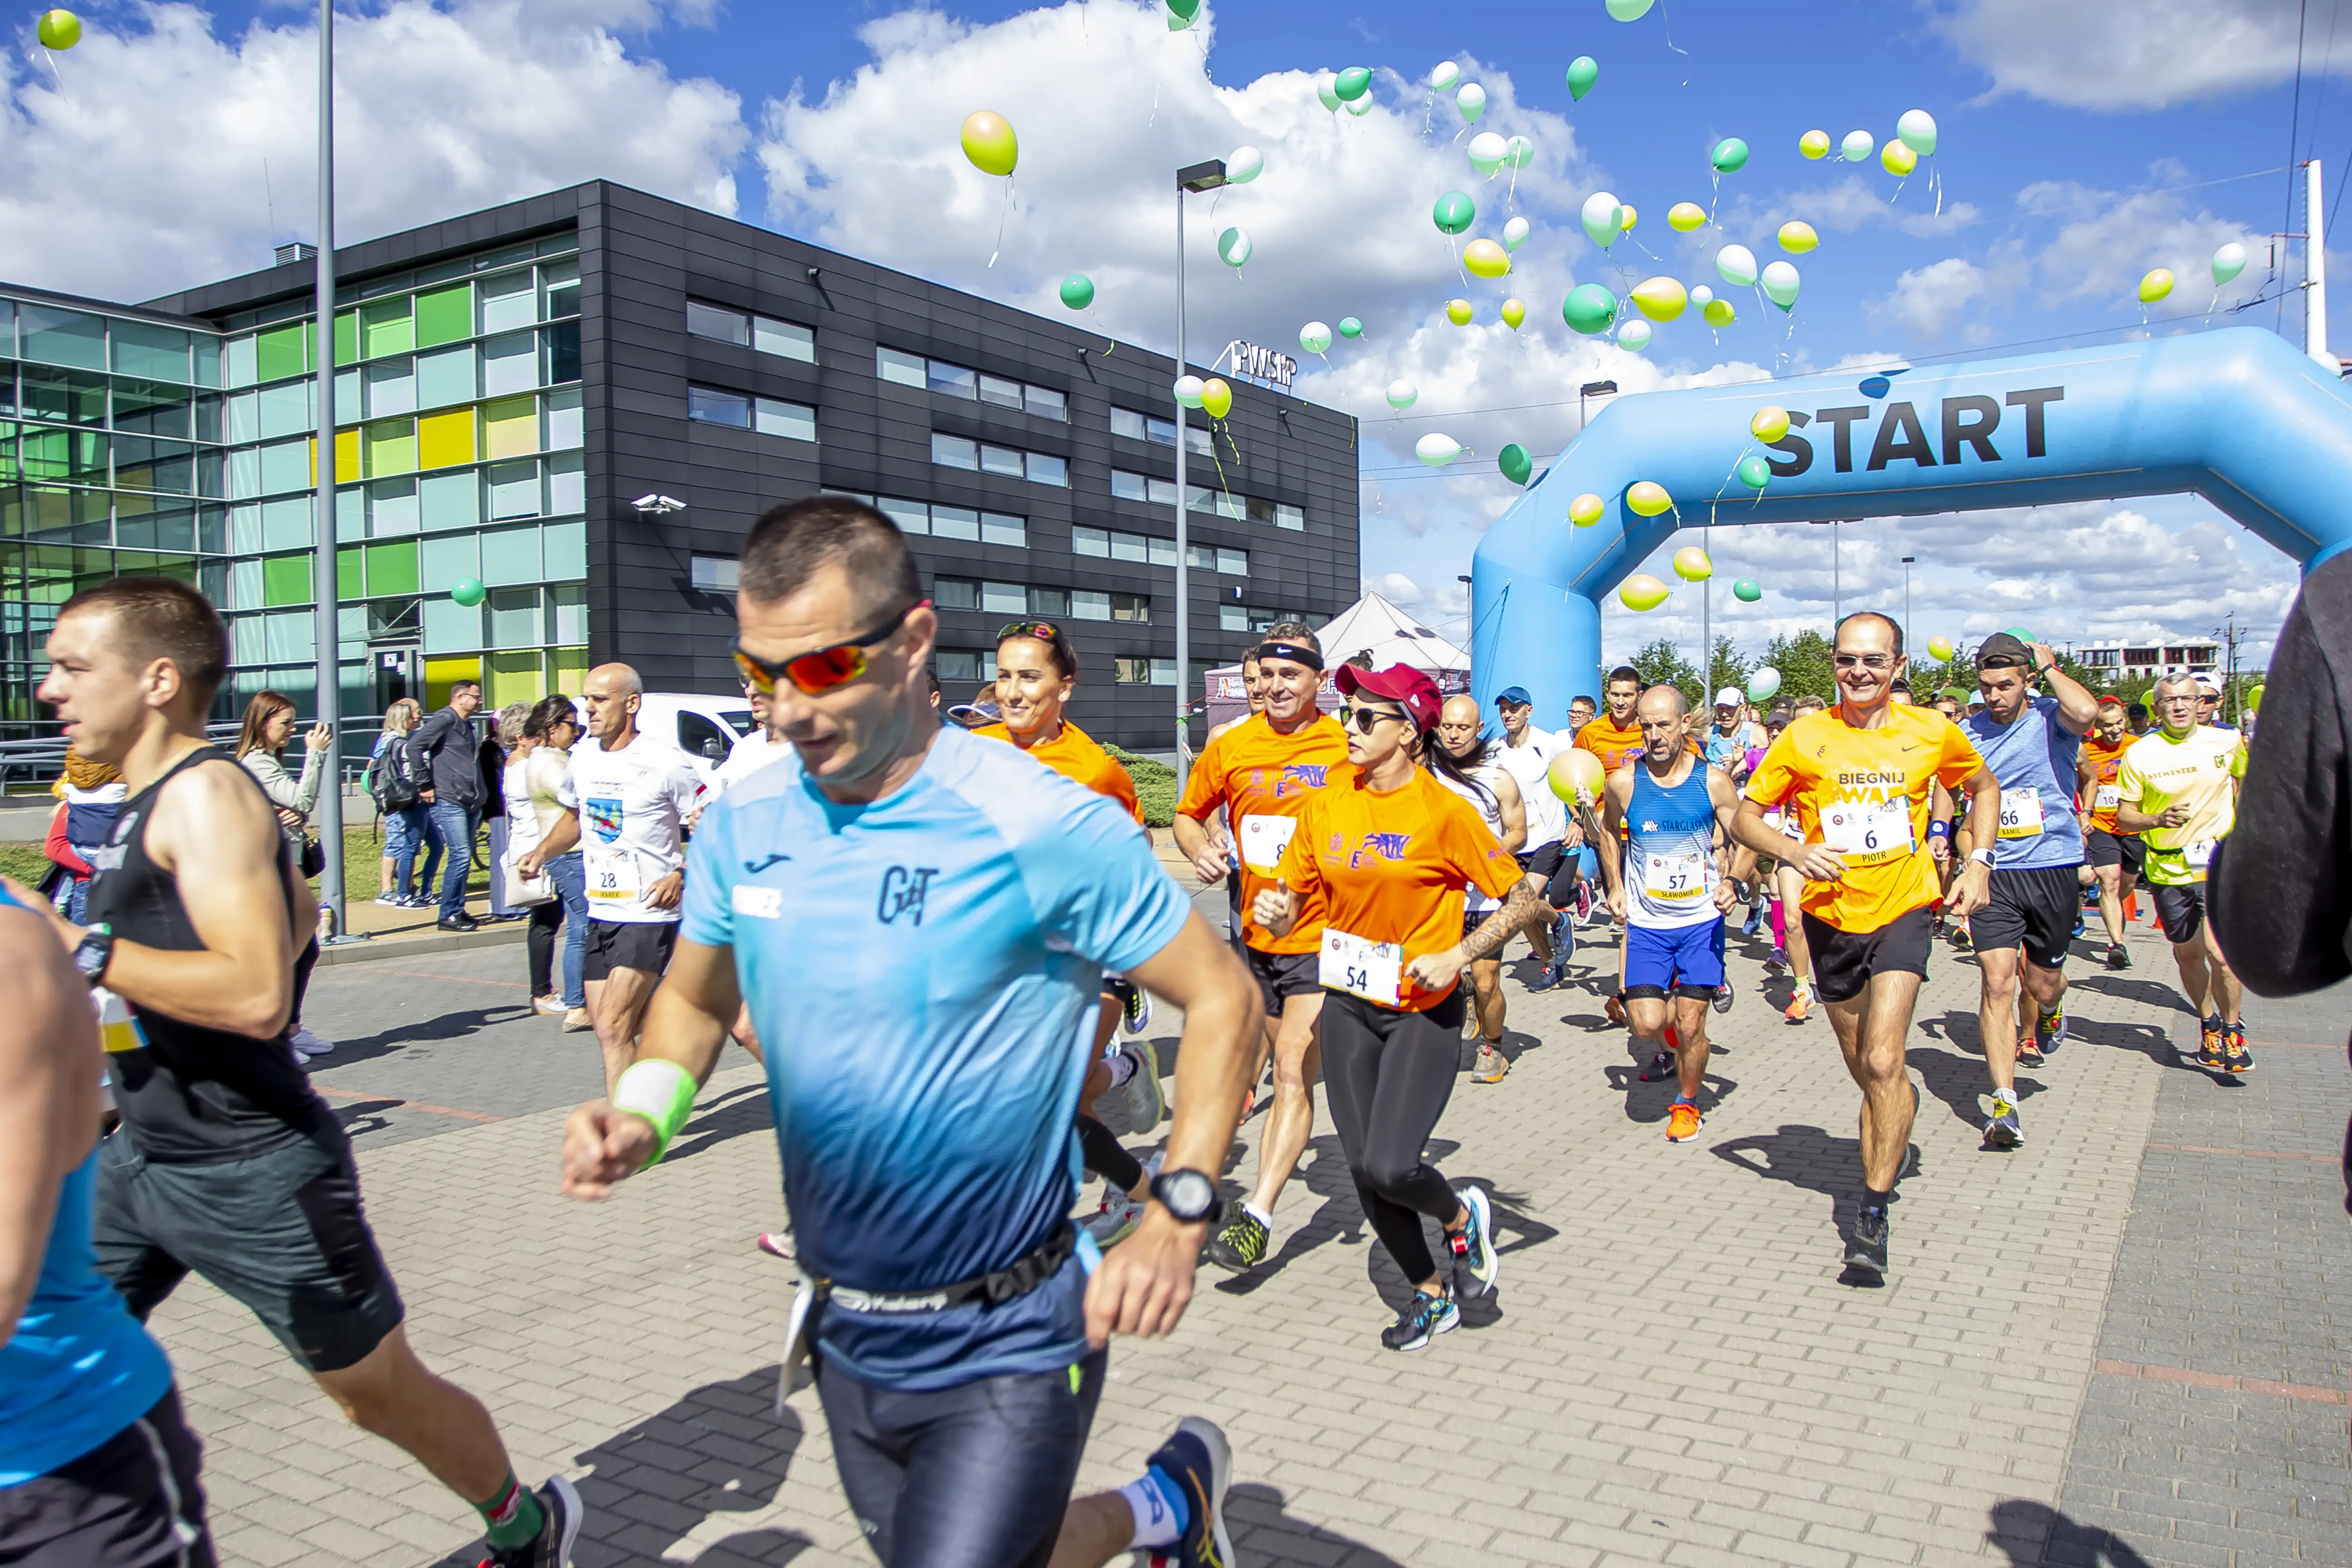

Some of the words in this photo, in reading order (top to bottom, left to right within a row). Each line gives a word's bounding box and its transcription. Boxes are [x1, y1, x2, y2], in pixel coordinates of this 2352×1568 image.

[1764, 386, 2064, 477] START
[1838, 772, 1905, 785] BIEGNIJ
[2001, 810, 2018, 825] 66
[1865, 830, 1877, 849] 6
[1862, 851, 1887, 862] PIOTR
[600, 872, 617, 888] 28
[1669, 874, 1687, 889] 57
[1661, 890, 1694, 898] SŁAWOMIR
[1347, 965, 1367, 991] 54
